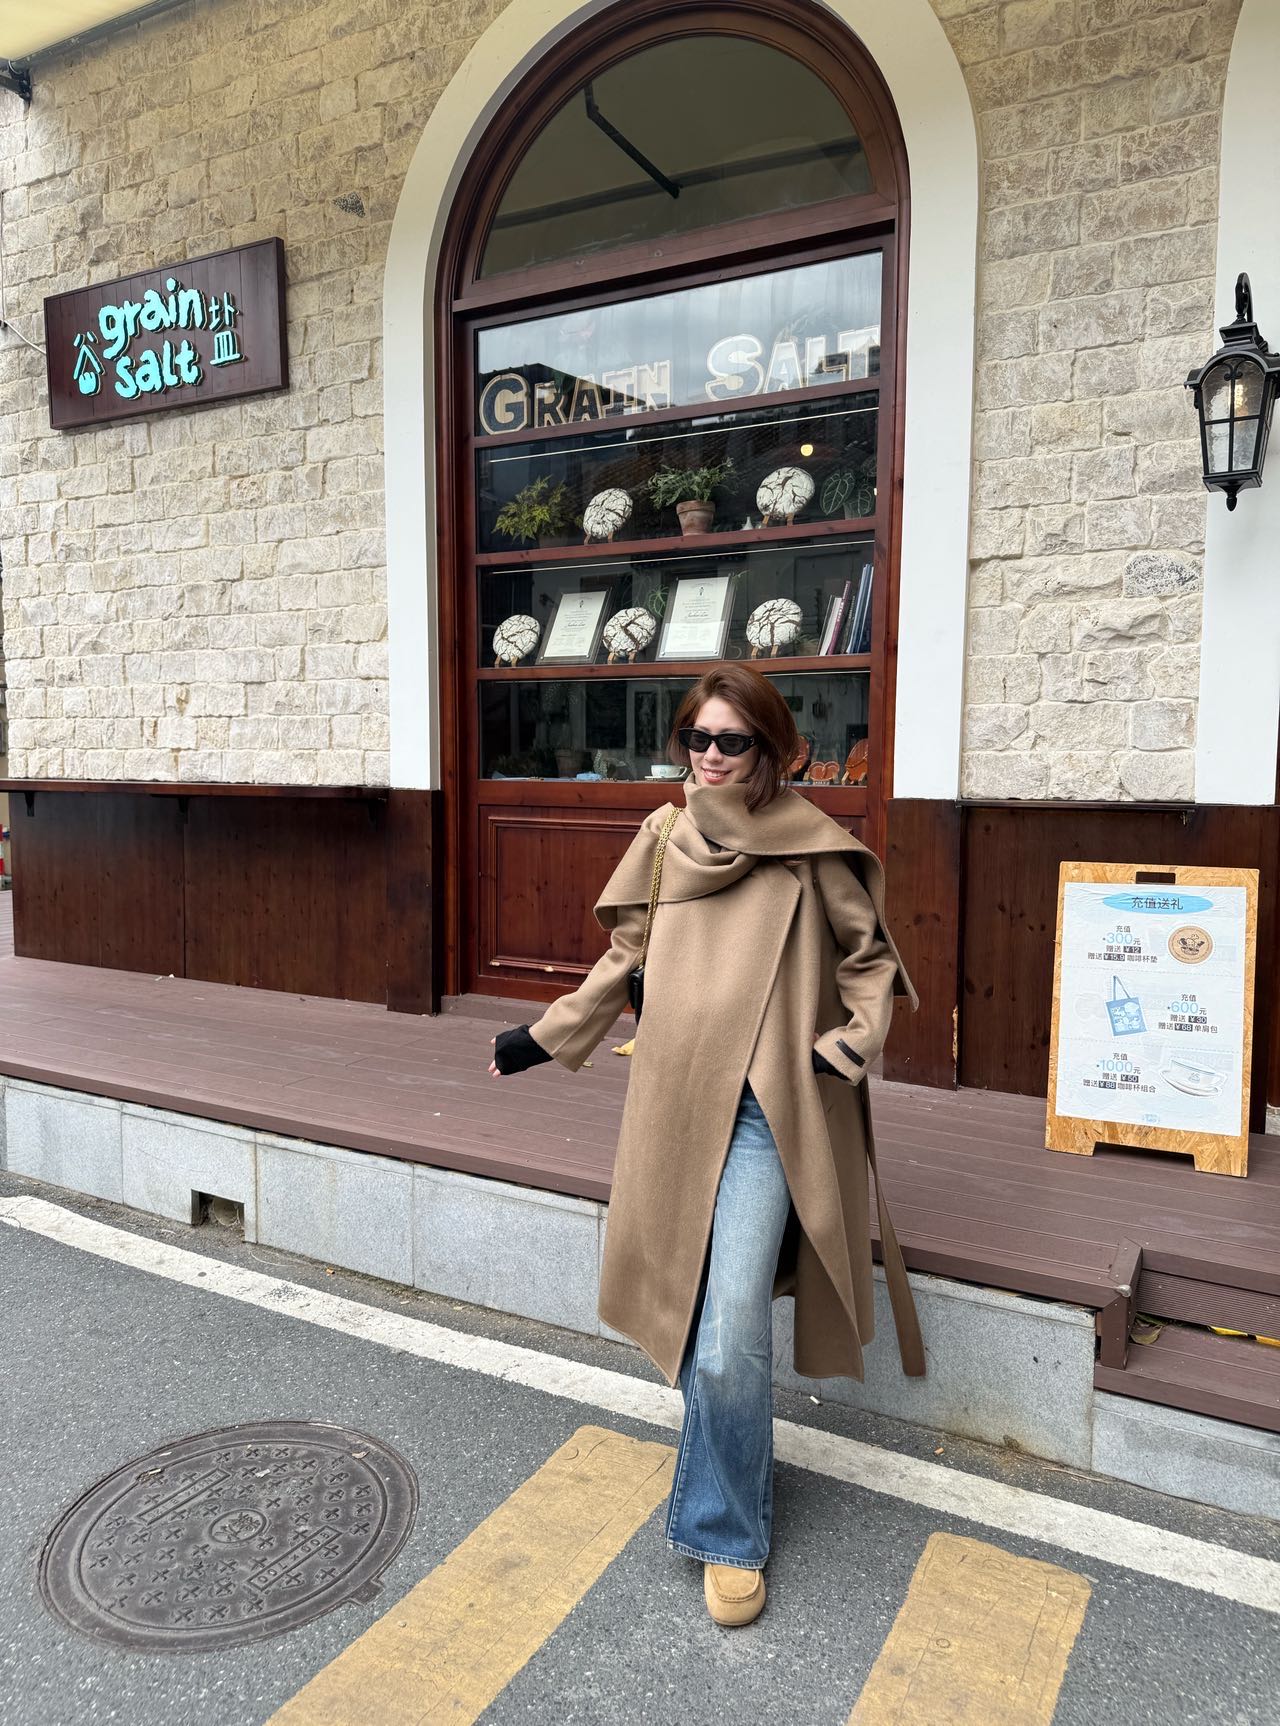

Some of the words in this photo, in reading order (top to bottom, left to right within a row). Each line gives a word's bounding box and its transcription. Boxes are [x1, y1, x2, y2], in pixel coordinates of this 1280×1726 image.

[98, 277, 208, 360] grain
[114, 339, 203, 400] salt
[480, 360, 671, 435] GRAIN
[705, 324, 881, 402] SALT
[1131, 897, 1184, 911] 充值送礼
[1115, 925, 1132, 934] 充值
[1105, 945, 1122, 953] 赠送
[1180, 994, 1197, 1003] 充值
[1170, 1014, 1187, 1023] 赠送
[1112, 1053, 1128, 1061] 充值
[1102, 1073, 1118, 1081] 赠送
